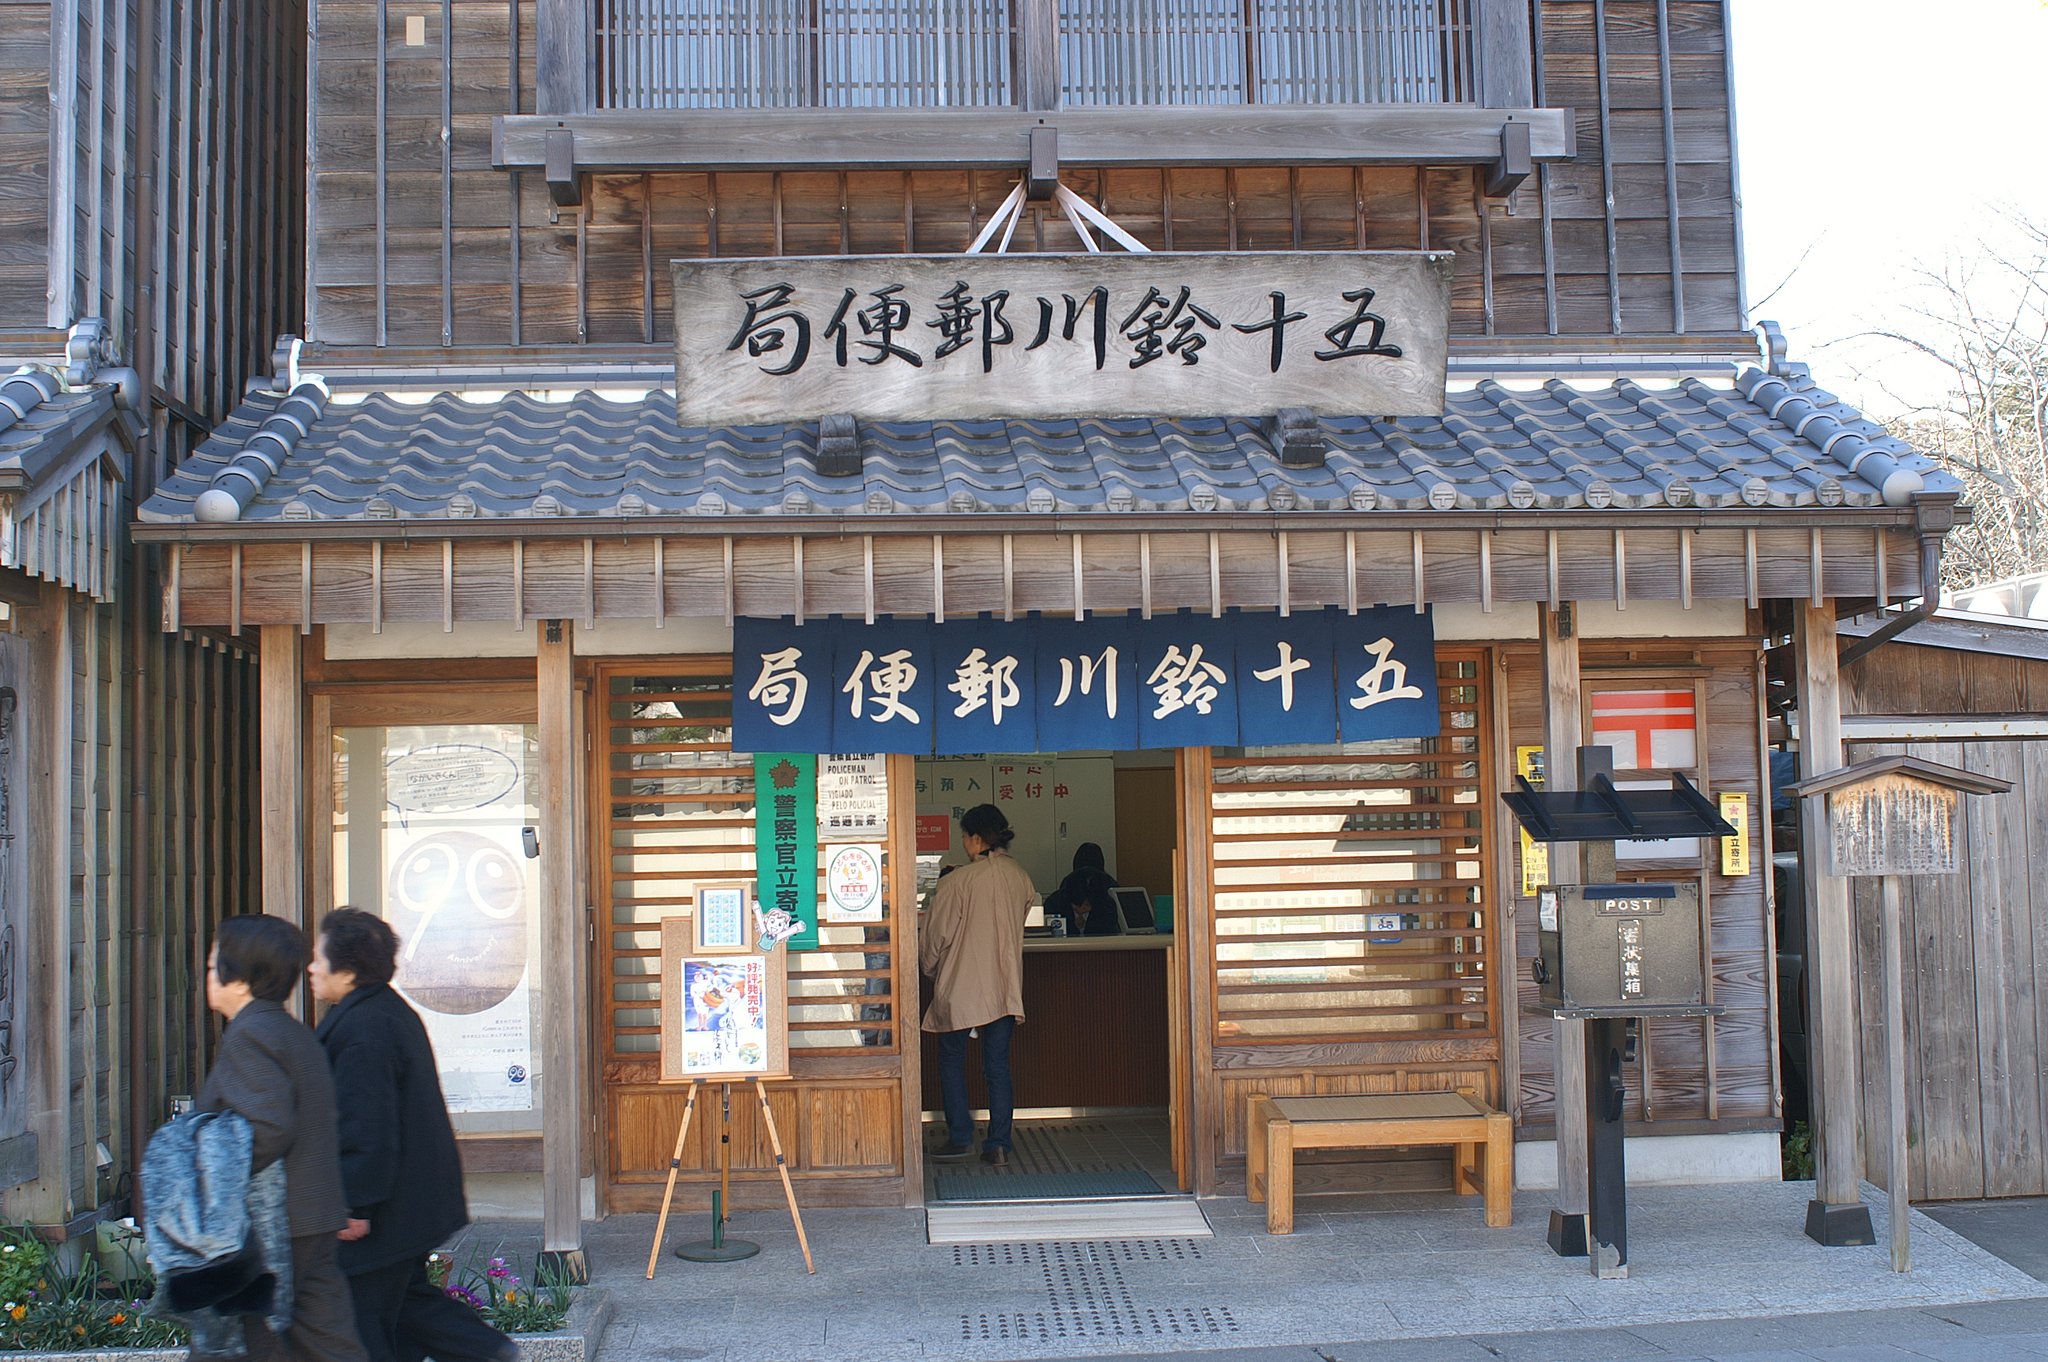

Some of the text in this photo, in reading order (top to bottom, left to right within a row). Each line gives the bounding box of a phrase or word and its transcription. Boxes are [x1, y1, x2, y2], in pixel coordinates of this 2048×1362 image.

[827, 765, 866, 774] POLICEMAN
[838, 775, 877, 786] ON PATROL
[999, 783, 1069, 800] 受付中
[832, 800, 876, 810] PELO POLICIAL
[1730, 818, 1741, 868] 警立寄所
[774, 794, 800, 936] 警察官立寄
[1605, 899, 1653, 911] POST
